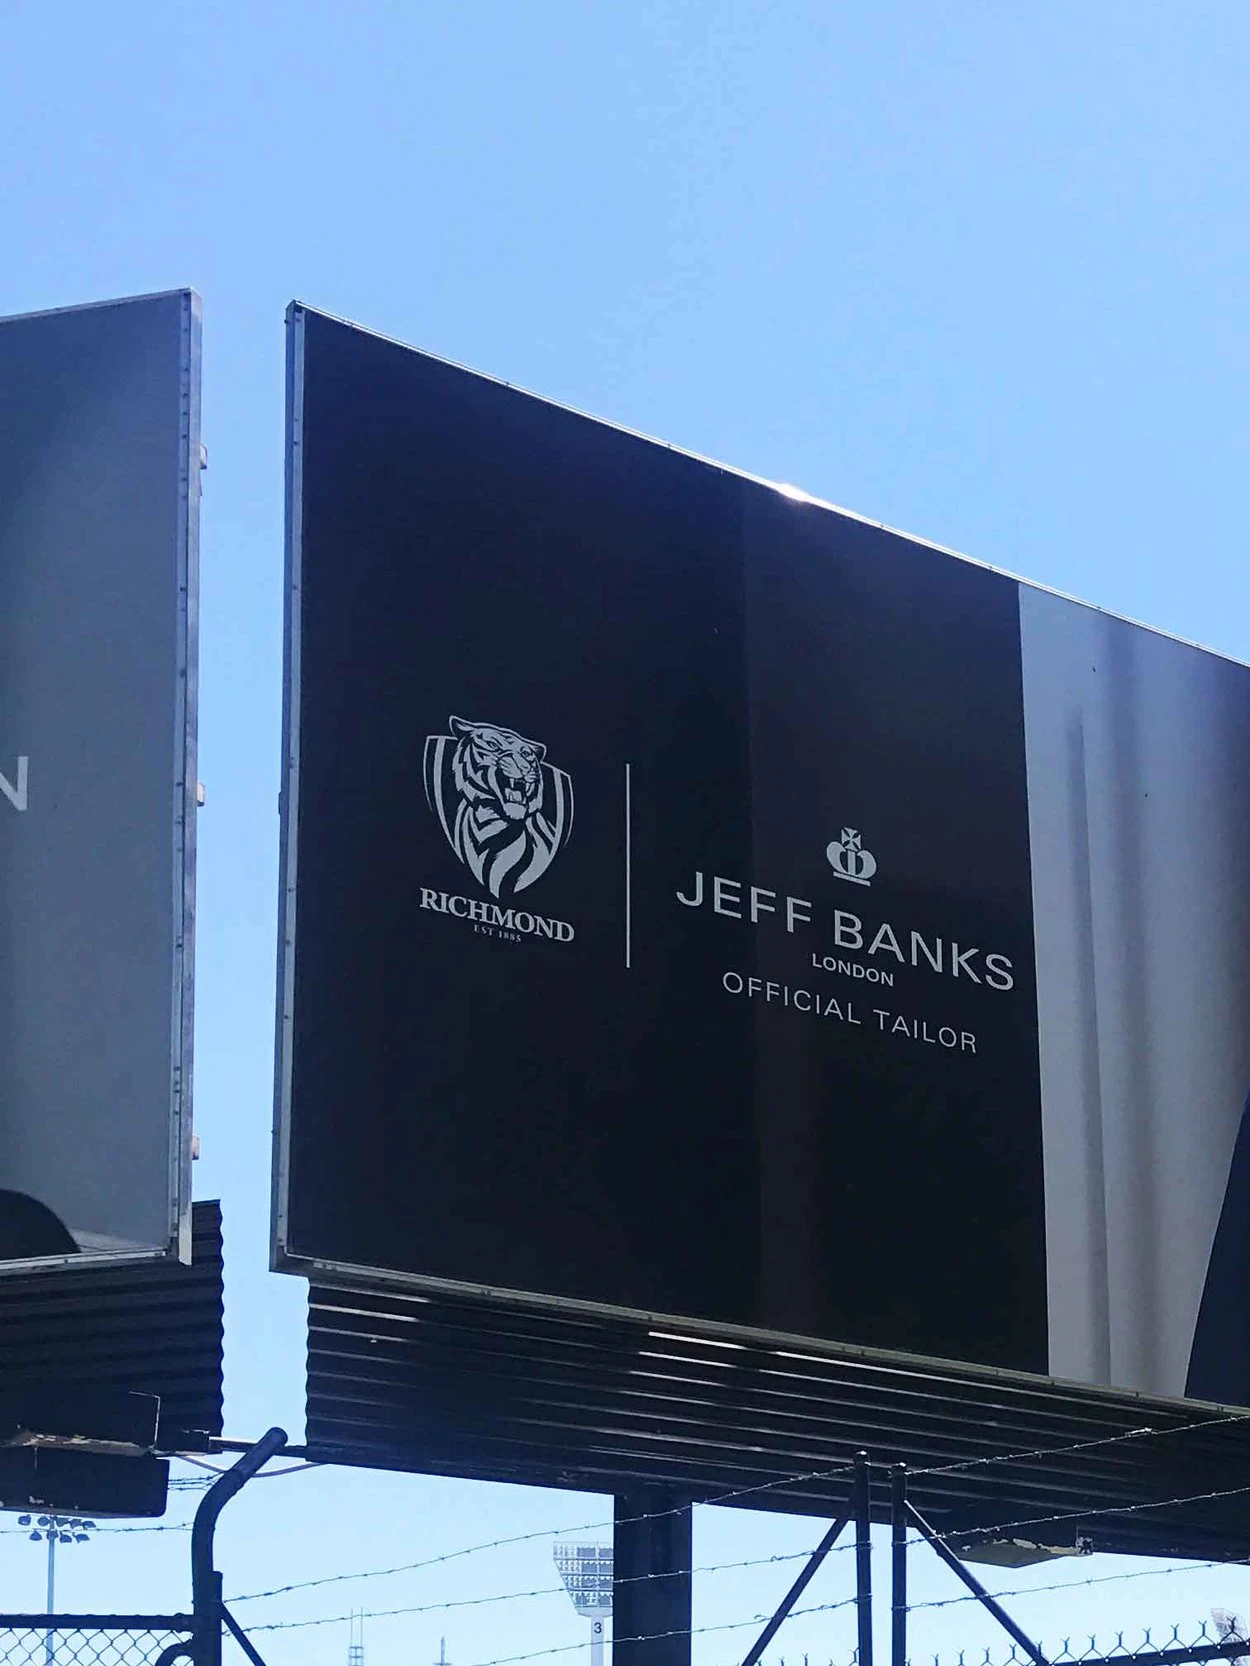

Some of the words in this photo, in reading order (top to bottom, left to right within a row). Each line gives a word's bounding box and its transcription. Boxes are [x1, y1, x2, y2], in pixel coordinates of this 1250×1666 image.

[419, 887, 575, 942] RICHMOND
[474, 924, 495, 936] EST
[676, 871, 812, 933] JEFF
[834, 909, 1014, 990] BANKS
[812, 953, 894, 987] LONDON
[723, 972, 861, 1024] OFFICIAL
[873, 1009, 976, 1053] TAILOR
[594, 1621, 602, 1634] 3
